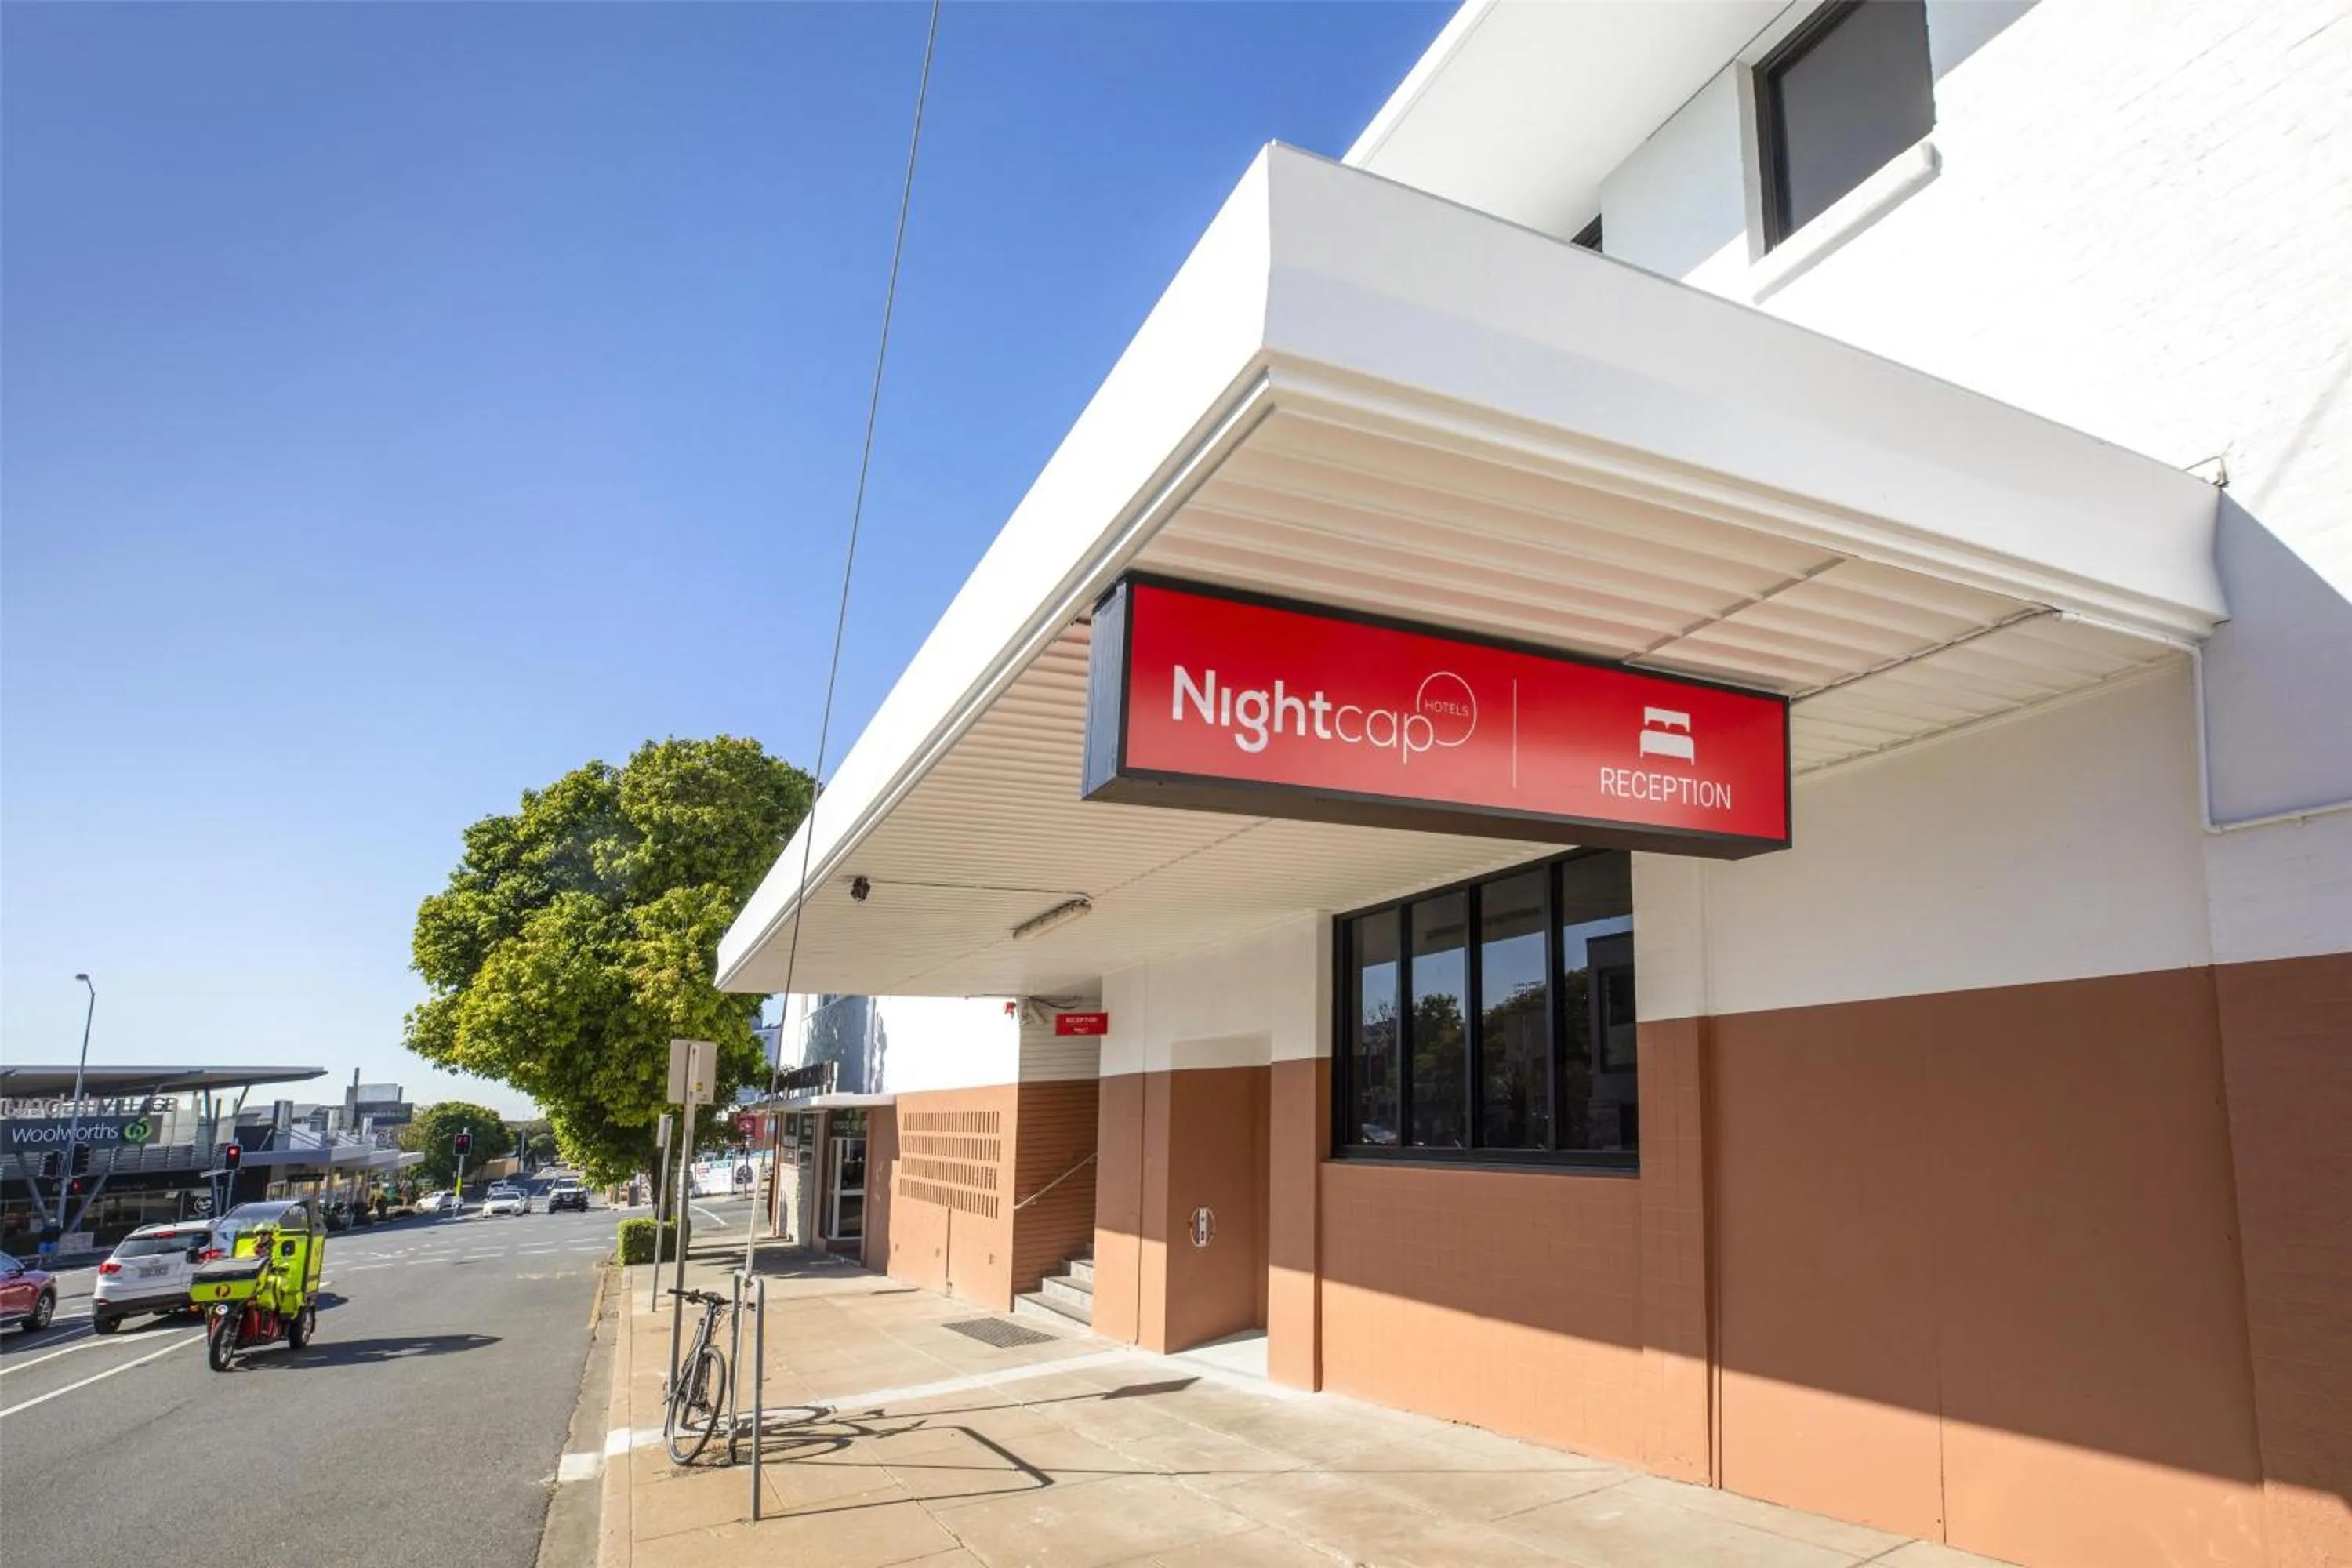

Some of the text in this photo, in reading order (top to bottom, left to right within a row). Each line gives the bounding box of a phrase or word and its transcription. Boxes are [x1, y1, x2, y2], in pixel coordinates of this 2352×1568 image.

[1172, 665, 1434, 764] Nightcap
[1424, 699, 1469, 717] HOTELS
[1600, 767, 1731, 810] RECEPTION
